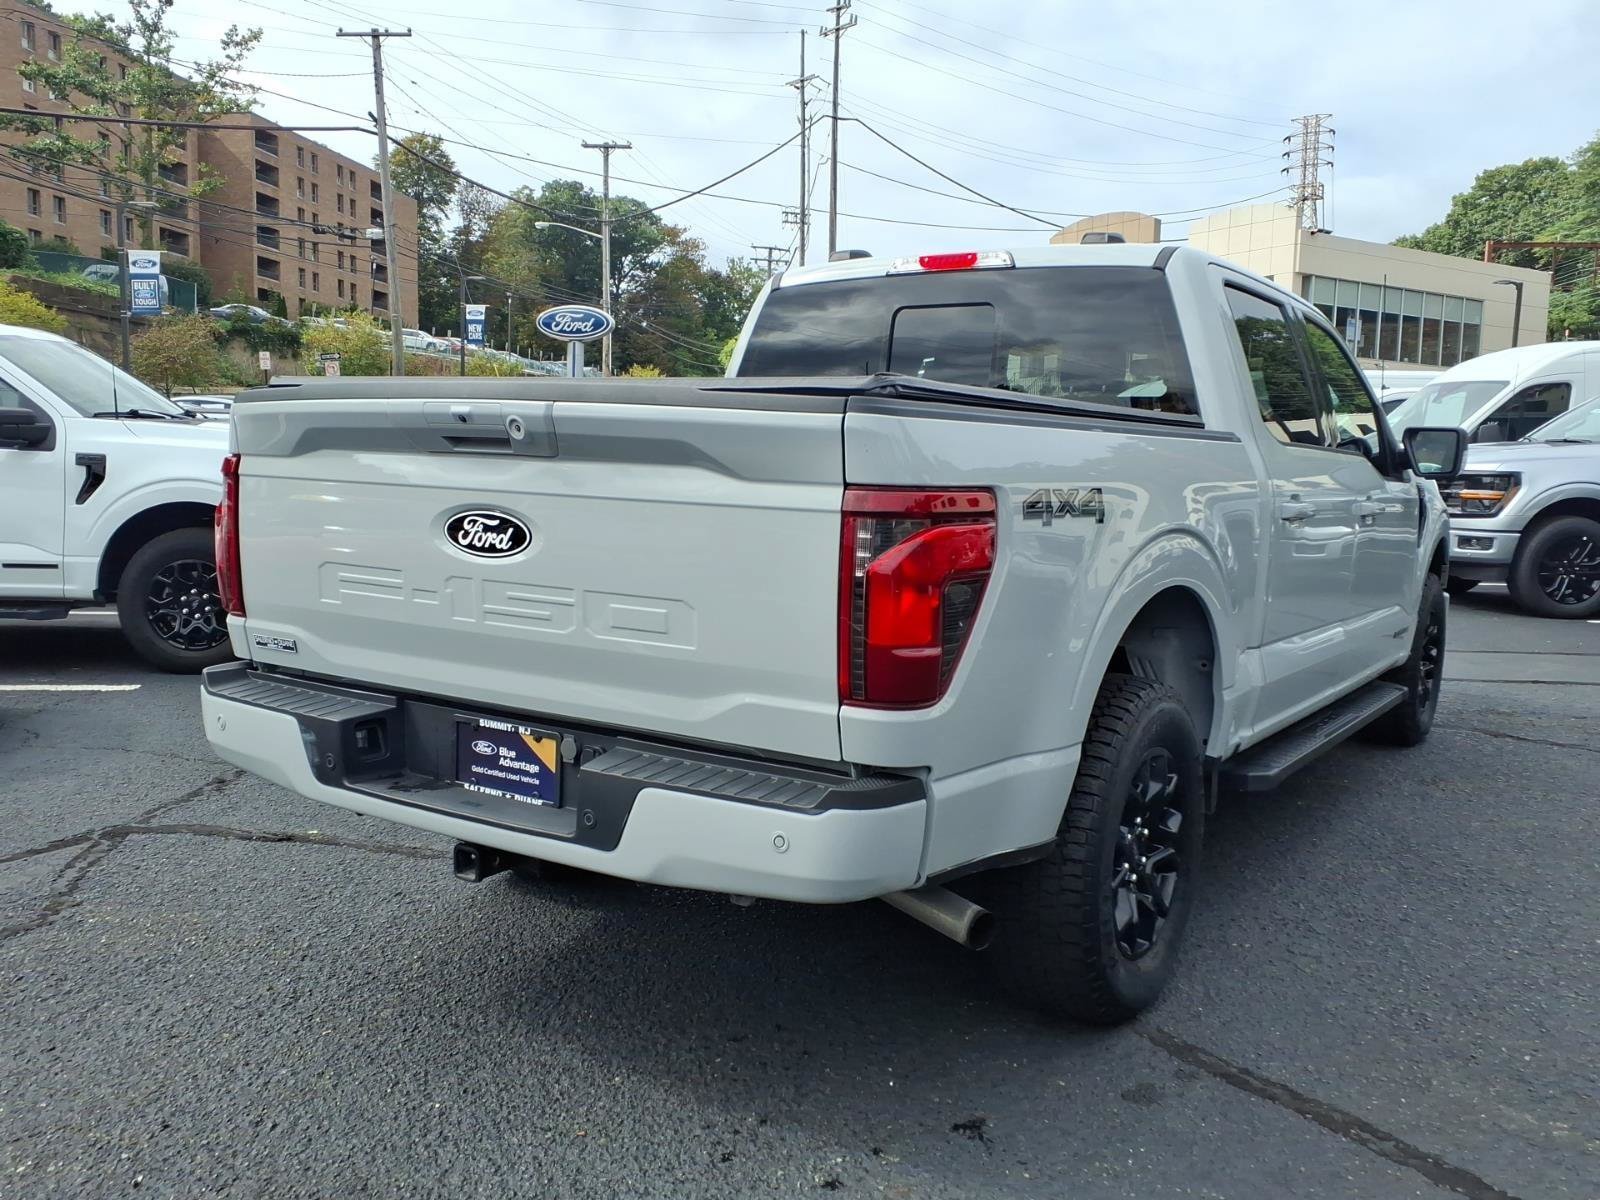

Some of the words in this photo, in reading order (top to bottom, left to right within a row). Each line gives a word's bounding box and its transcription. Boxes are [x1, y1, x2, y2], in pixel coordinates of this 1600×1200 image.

[134, 281, 155, 290] BUILT
[135, 298, 157, 306] TOUGH
[468, 323, 482, 332] NEW
[551, 312, 595, 332] Ford
[469, 332, 482, 340] CARS
[1022, 487, 1105, 527] 4X4
[458, 516, 513, 551] Ford
[318, 560, 698, 651] F-150
[518, 726, 531, 735] NJ
[499, 746, 516, 758] Blue
[499, 757, 540, 774] Advantage
[471, 765, 484, 774] Gold
[484, 767, 506, 778] Certified
[506, 773, 520, 781] Used
[520, 775, 540, 785] Vehicle
